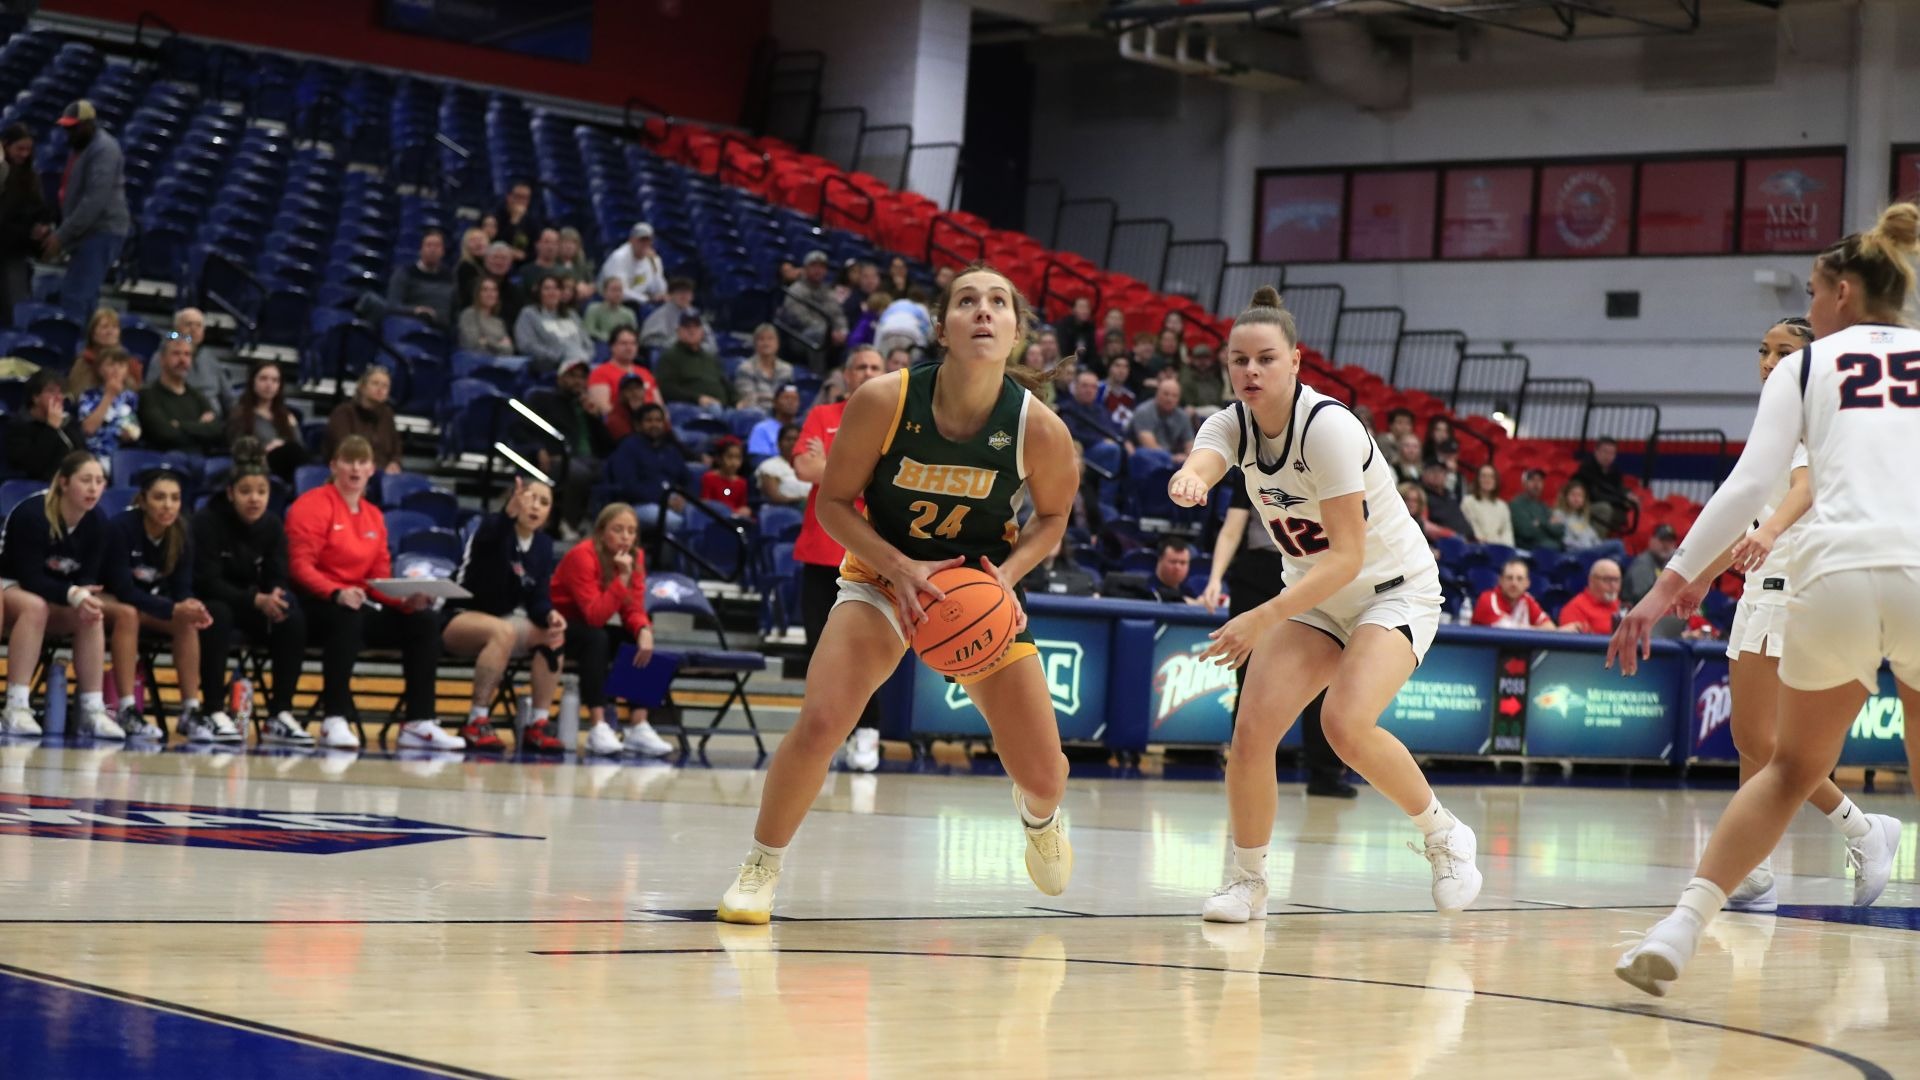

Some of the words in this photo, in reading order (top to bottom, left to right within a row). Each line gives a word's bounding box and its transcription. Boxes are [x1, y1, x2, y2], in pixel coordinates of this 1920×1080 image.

[1766, 203, 1819, 225] MSU
[1836, 350, 1920, 411] 25
[893, 456, 998, 499] BHSU
[909, 501, 971, 539] 24
[1269, 517, 1329, 557] 12
[955, 628, 993, 662] EVO
